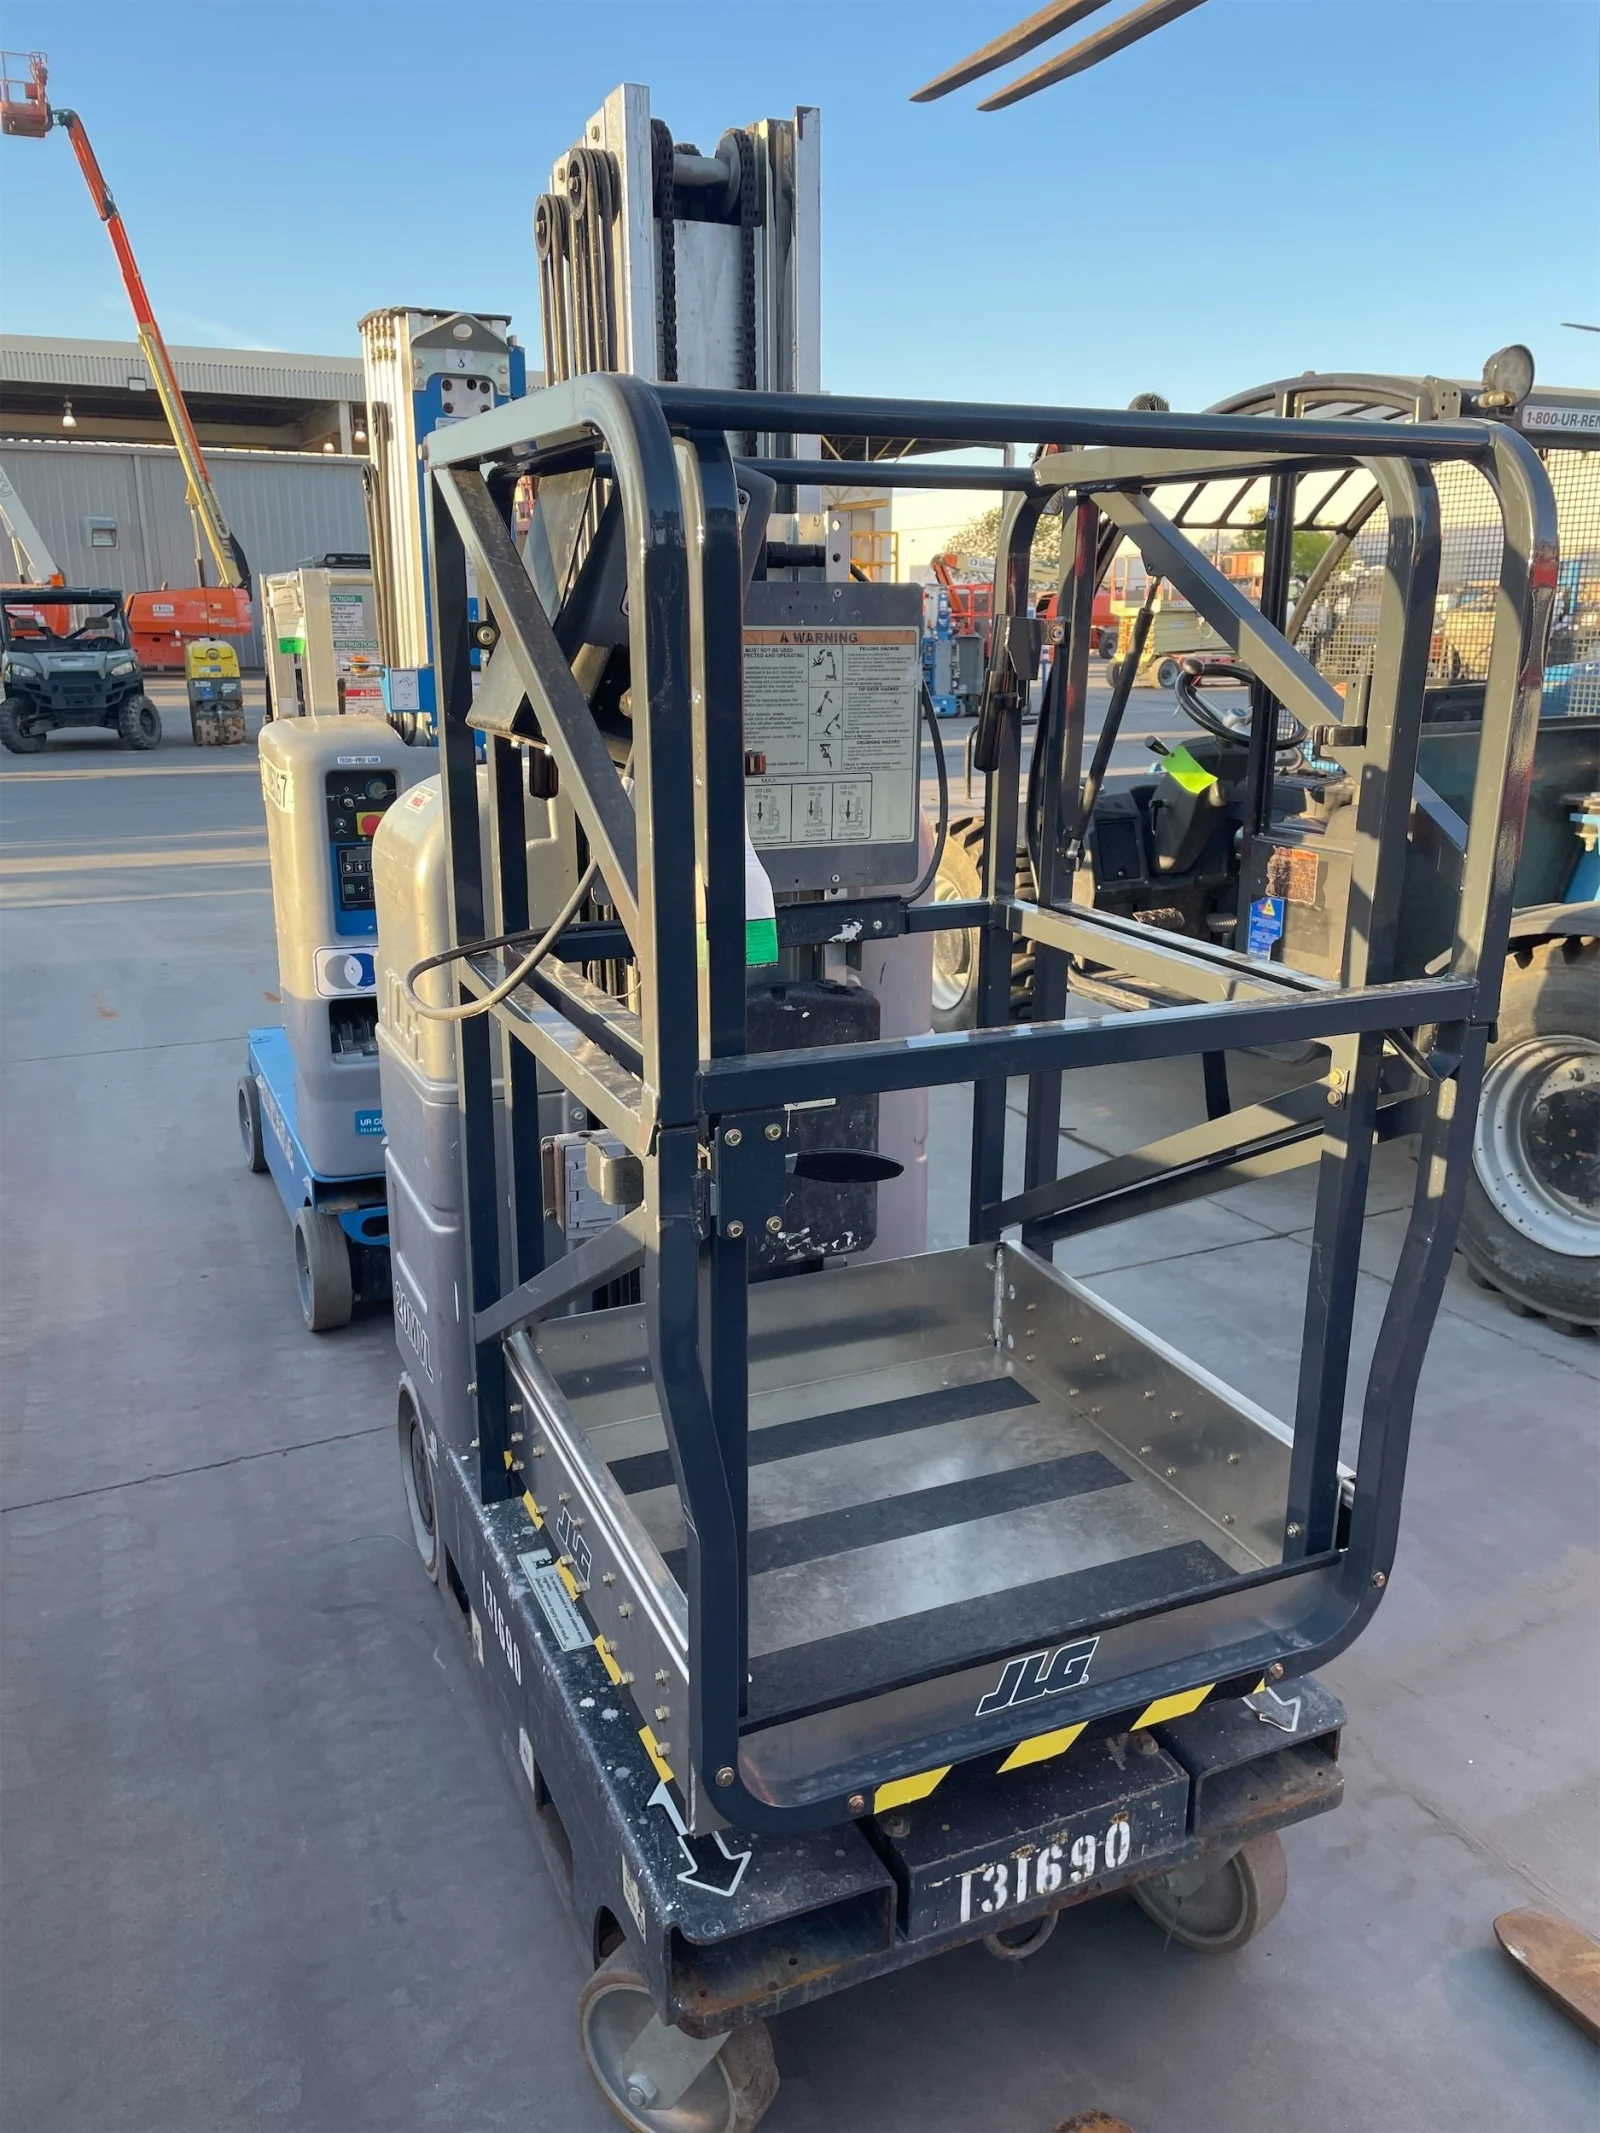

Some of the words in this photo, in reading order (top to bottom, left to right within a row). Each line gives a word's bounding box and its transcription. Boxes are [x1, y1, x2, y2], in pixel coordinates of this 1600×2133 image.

[793, 632, 858, 643] WARNING
[360, 1118, 372, 1126] UR
[975, 1636, 1100, 1716] JLG
